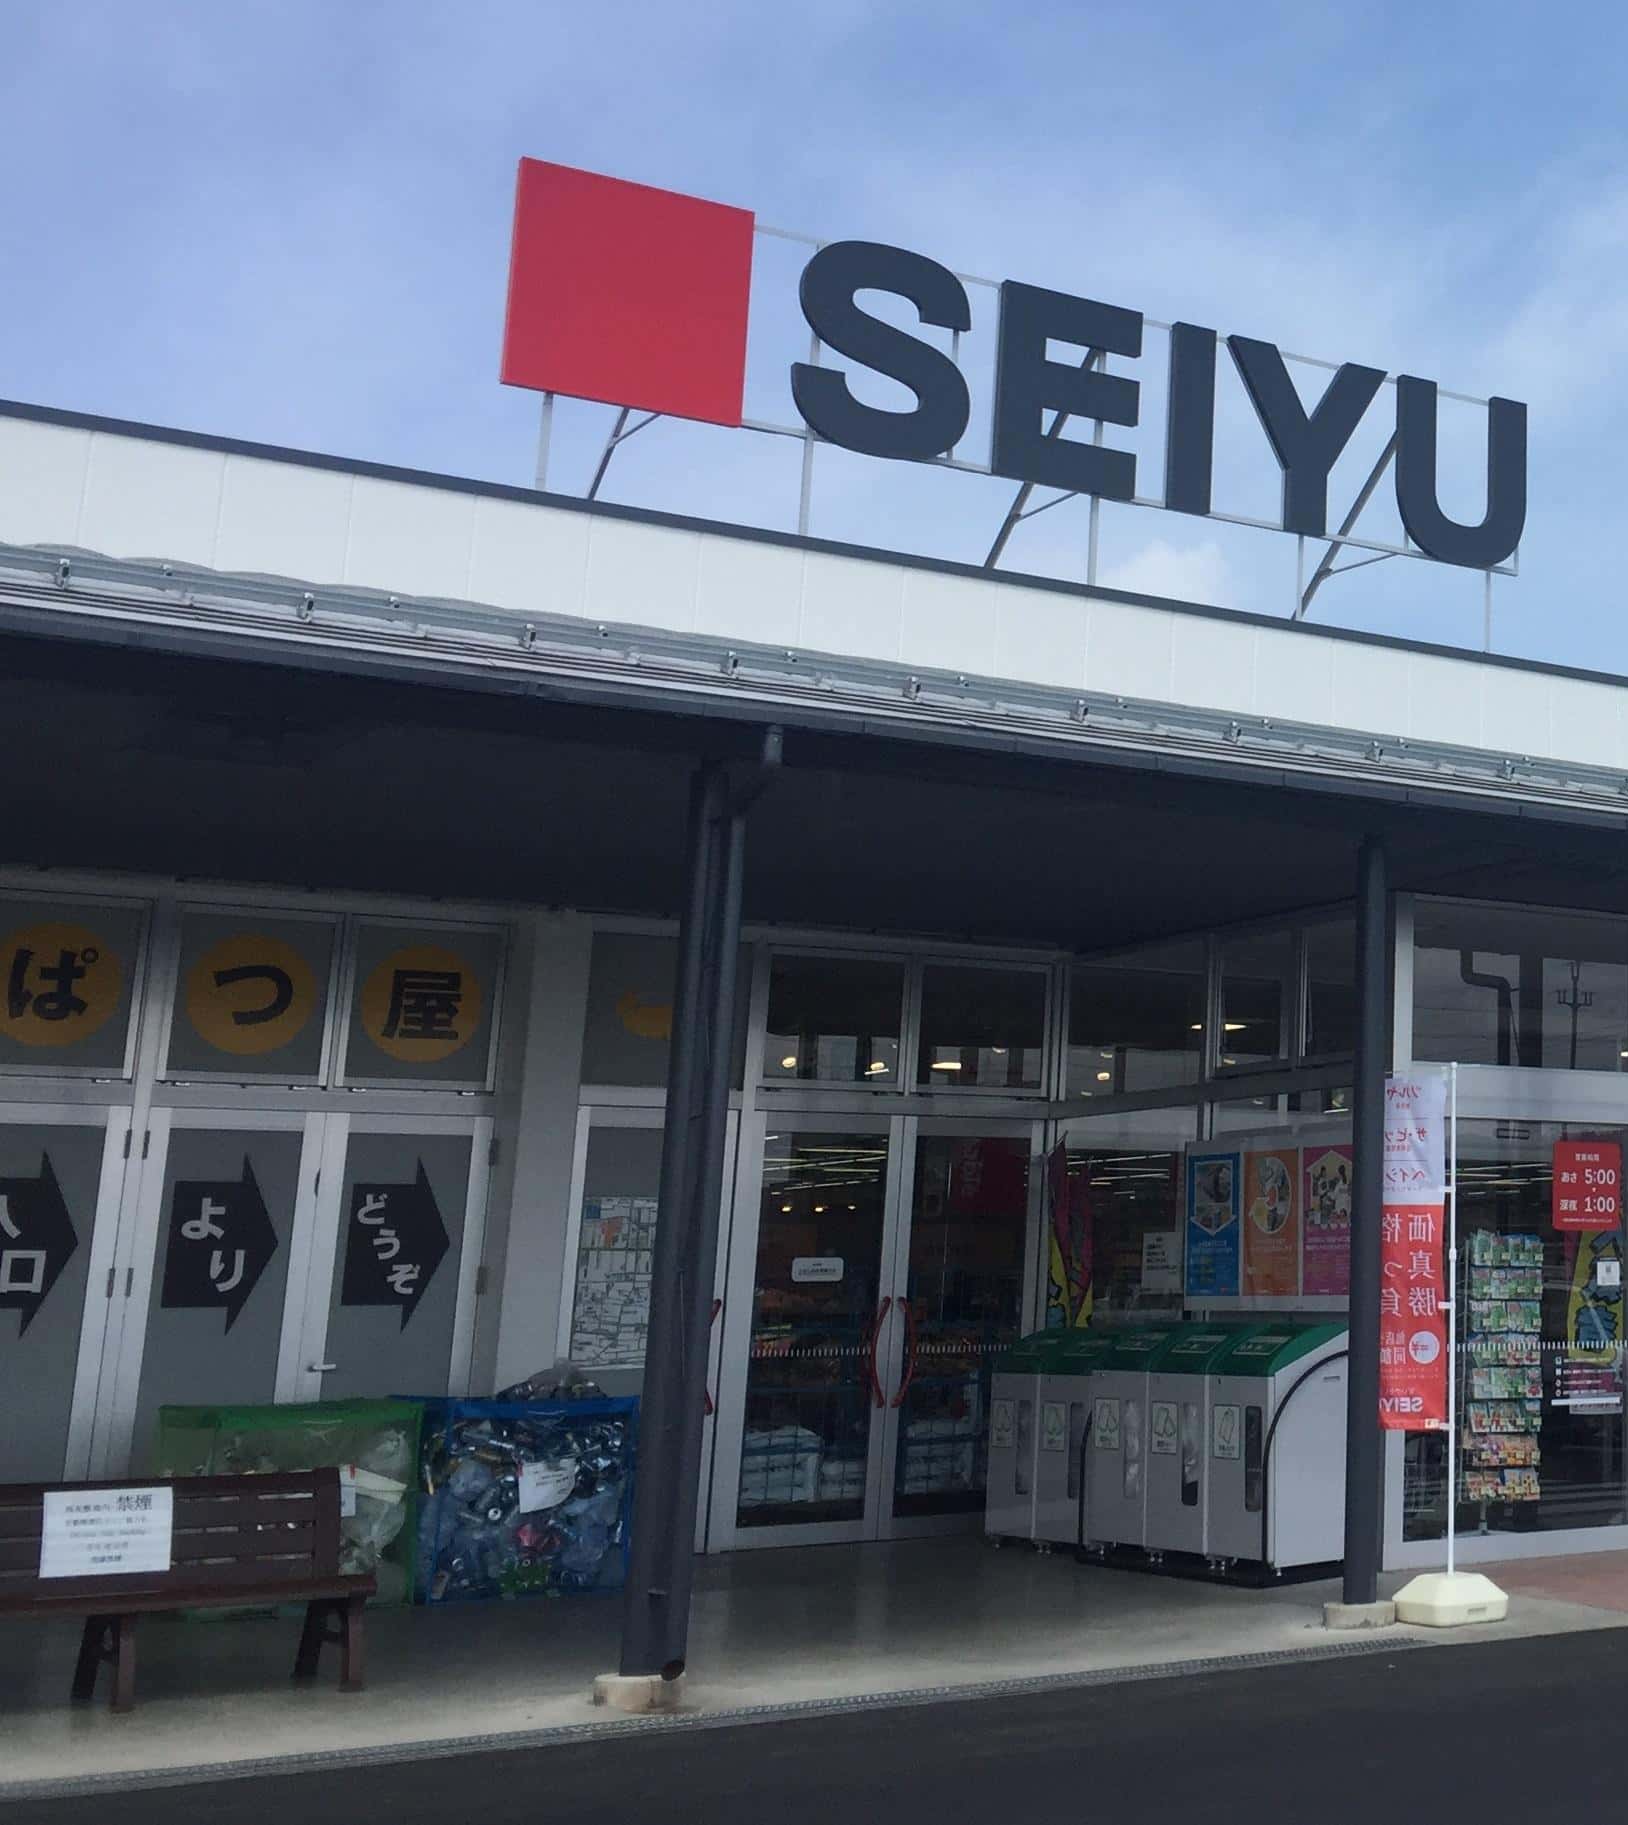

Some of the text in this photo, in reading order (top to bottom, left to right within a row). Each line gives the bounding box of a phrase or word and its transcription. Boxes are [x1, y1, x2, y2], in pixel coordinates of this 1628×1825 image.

[790, 239, 1527, 567] SEIYU
[1584, 1168, 1616, 1185] 5:00
[1584, 1196, 1615, 1213] 1:00
[181, 1197, 246, 1293] より
[356, 1192, 422, 1295] どうぞ
